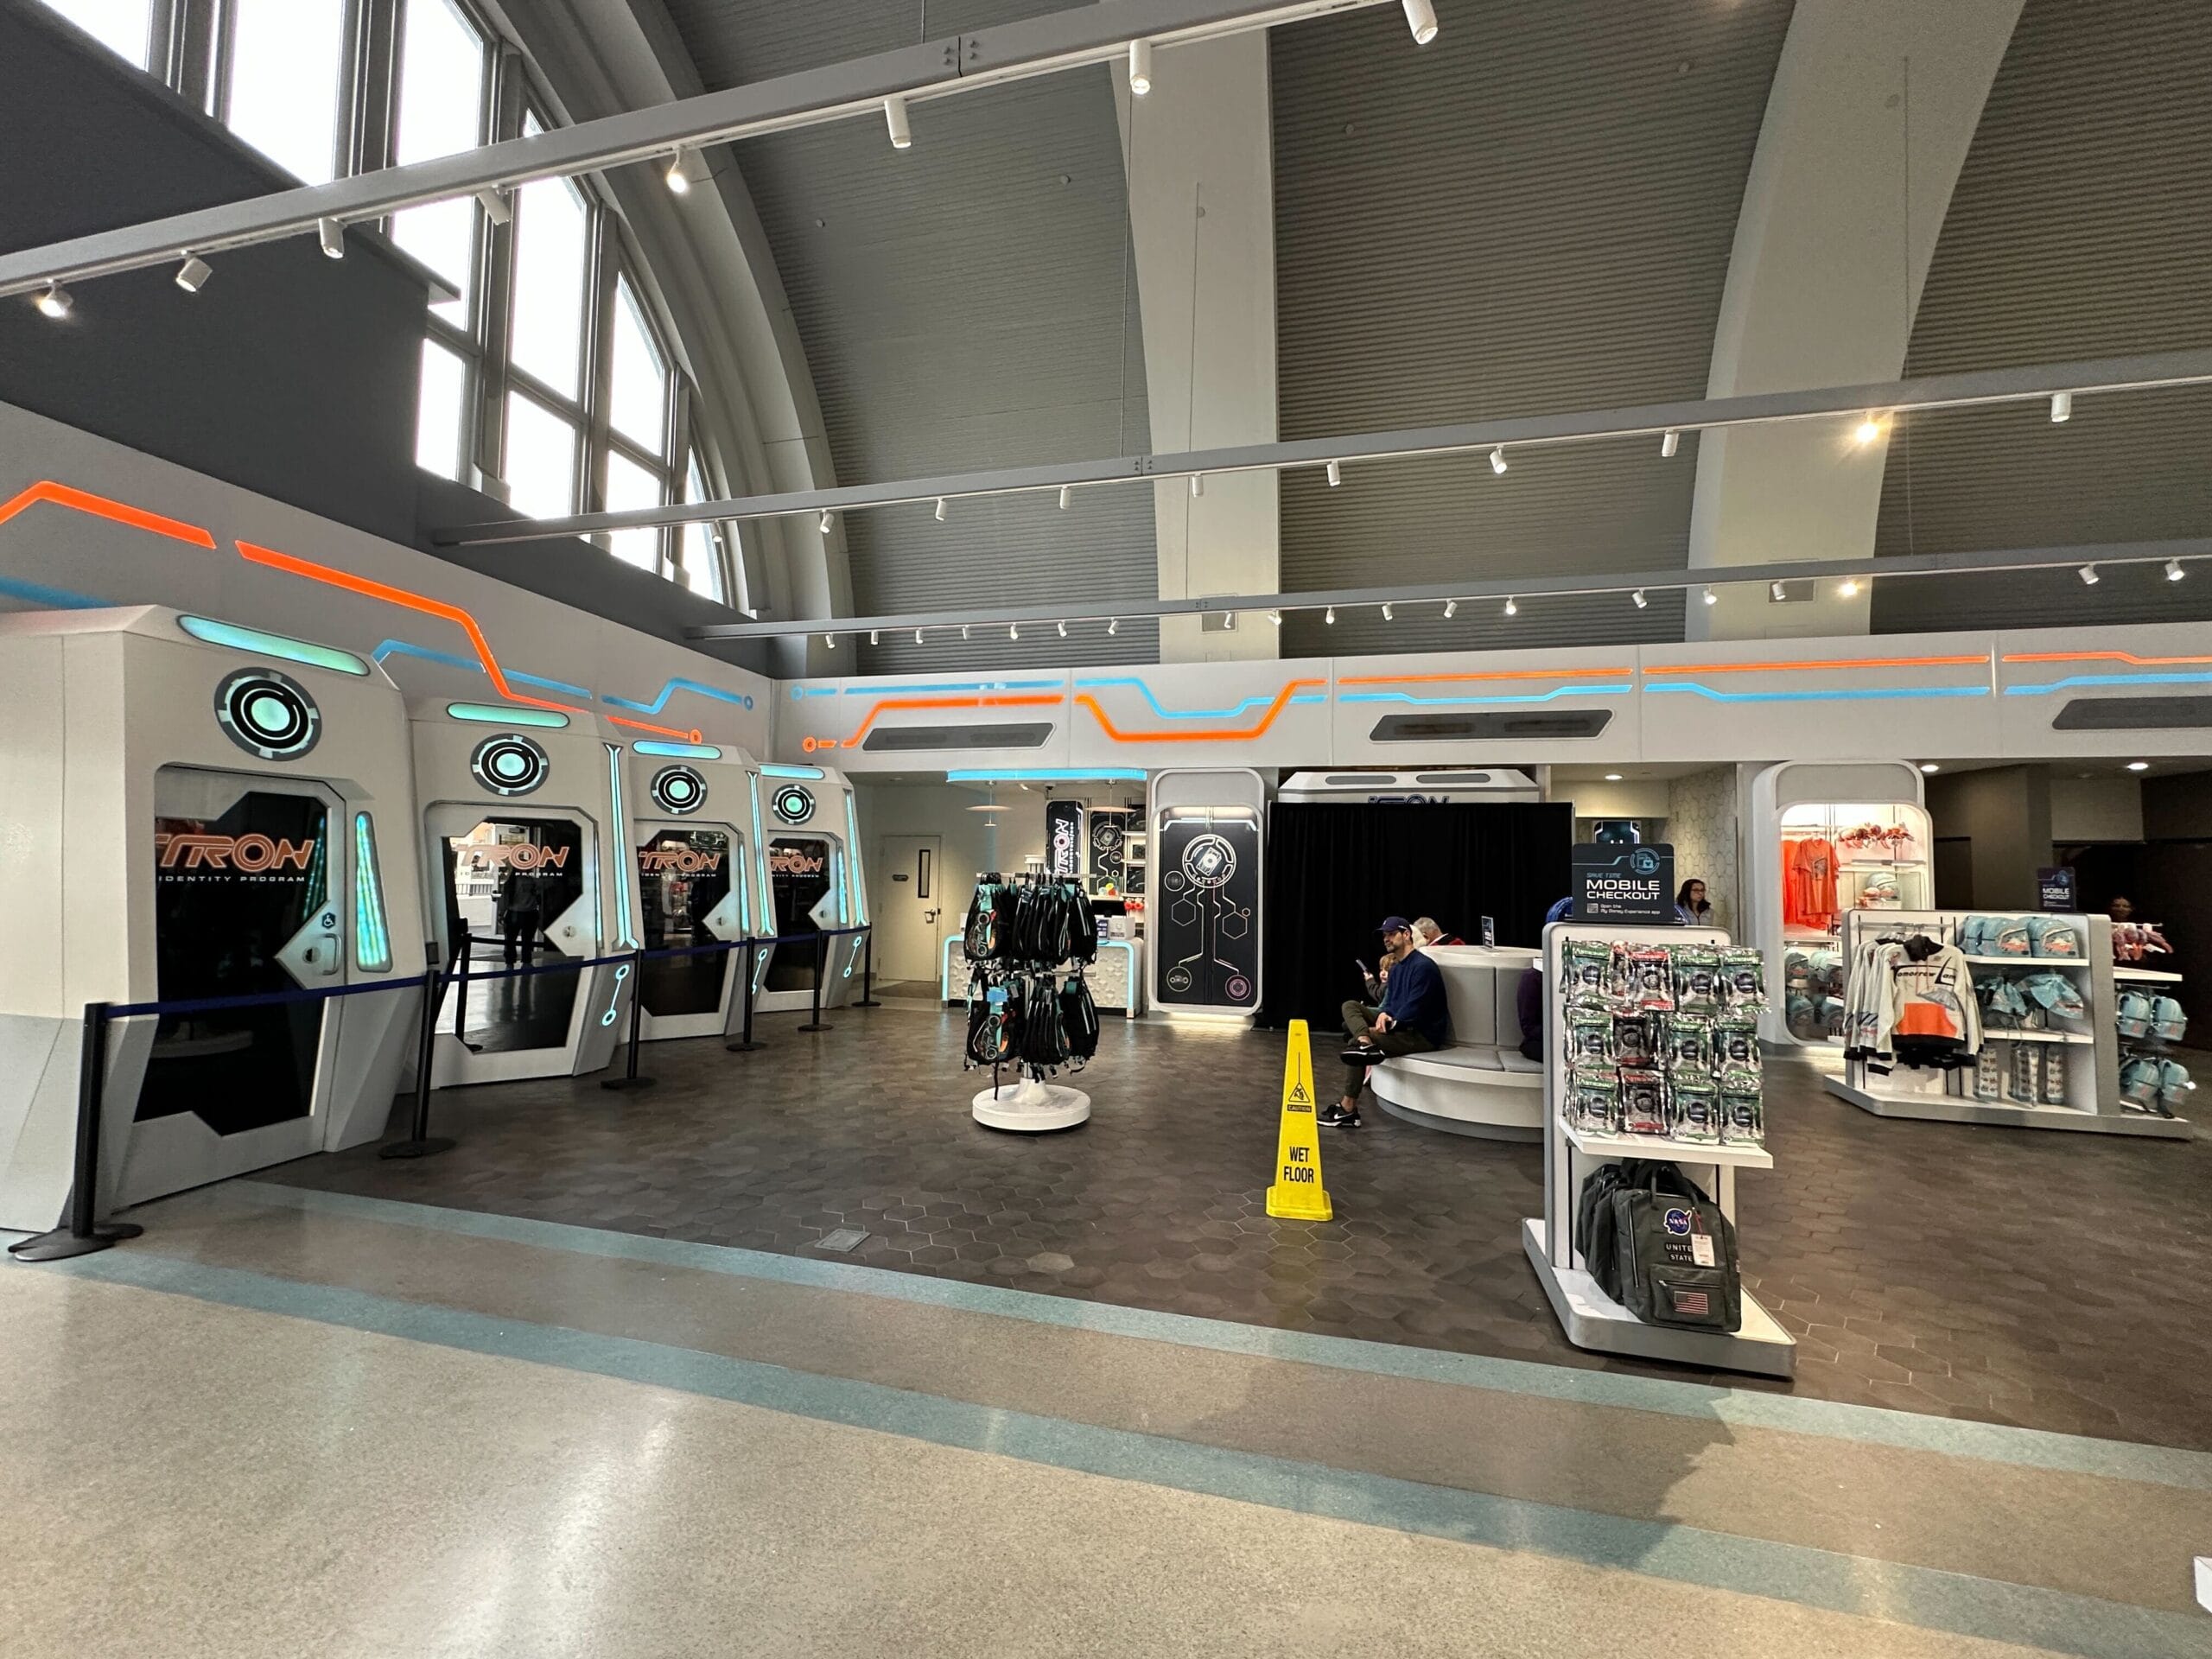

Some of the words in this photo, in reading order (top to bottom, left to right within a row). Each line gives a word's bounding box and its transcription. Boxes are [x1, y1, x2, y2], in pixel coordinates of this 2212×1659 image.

[156, 833, 315, 873] TRON
[455, 842, 570, 871] TRON
[638, 850, 721, 873] TRON
[1586, 880, 1661, 891] MOBILE
[1586, 891, 1661, 900] CHECKOUT
[1288, 1146, 1310, 1162] WET
[1283, 1166, 1314, 1183] FLOOR
[1669, 1217, 1688, 1226] NASA
[1665, 1243, 1693, 1252] UNITE
[1670, 1254, 1693, 1262] STATE
